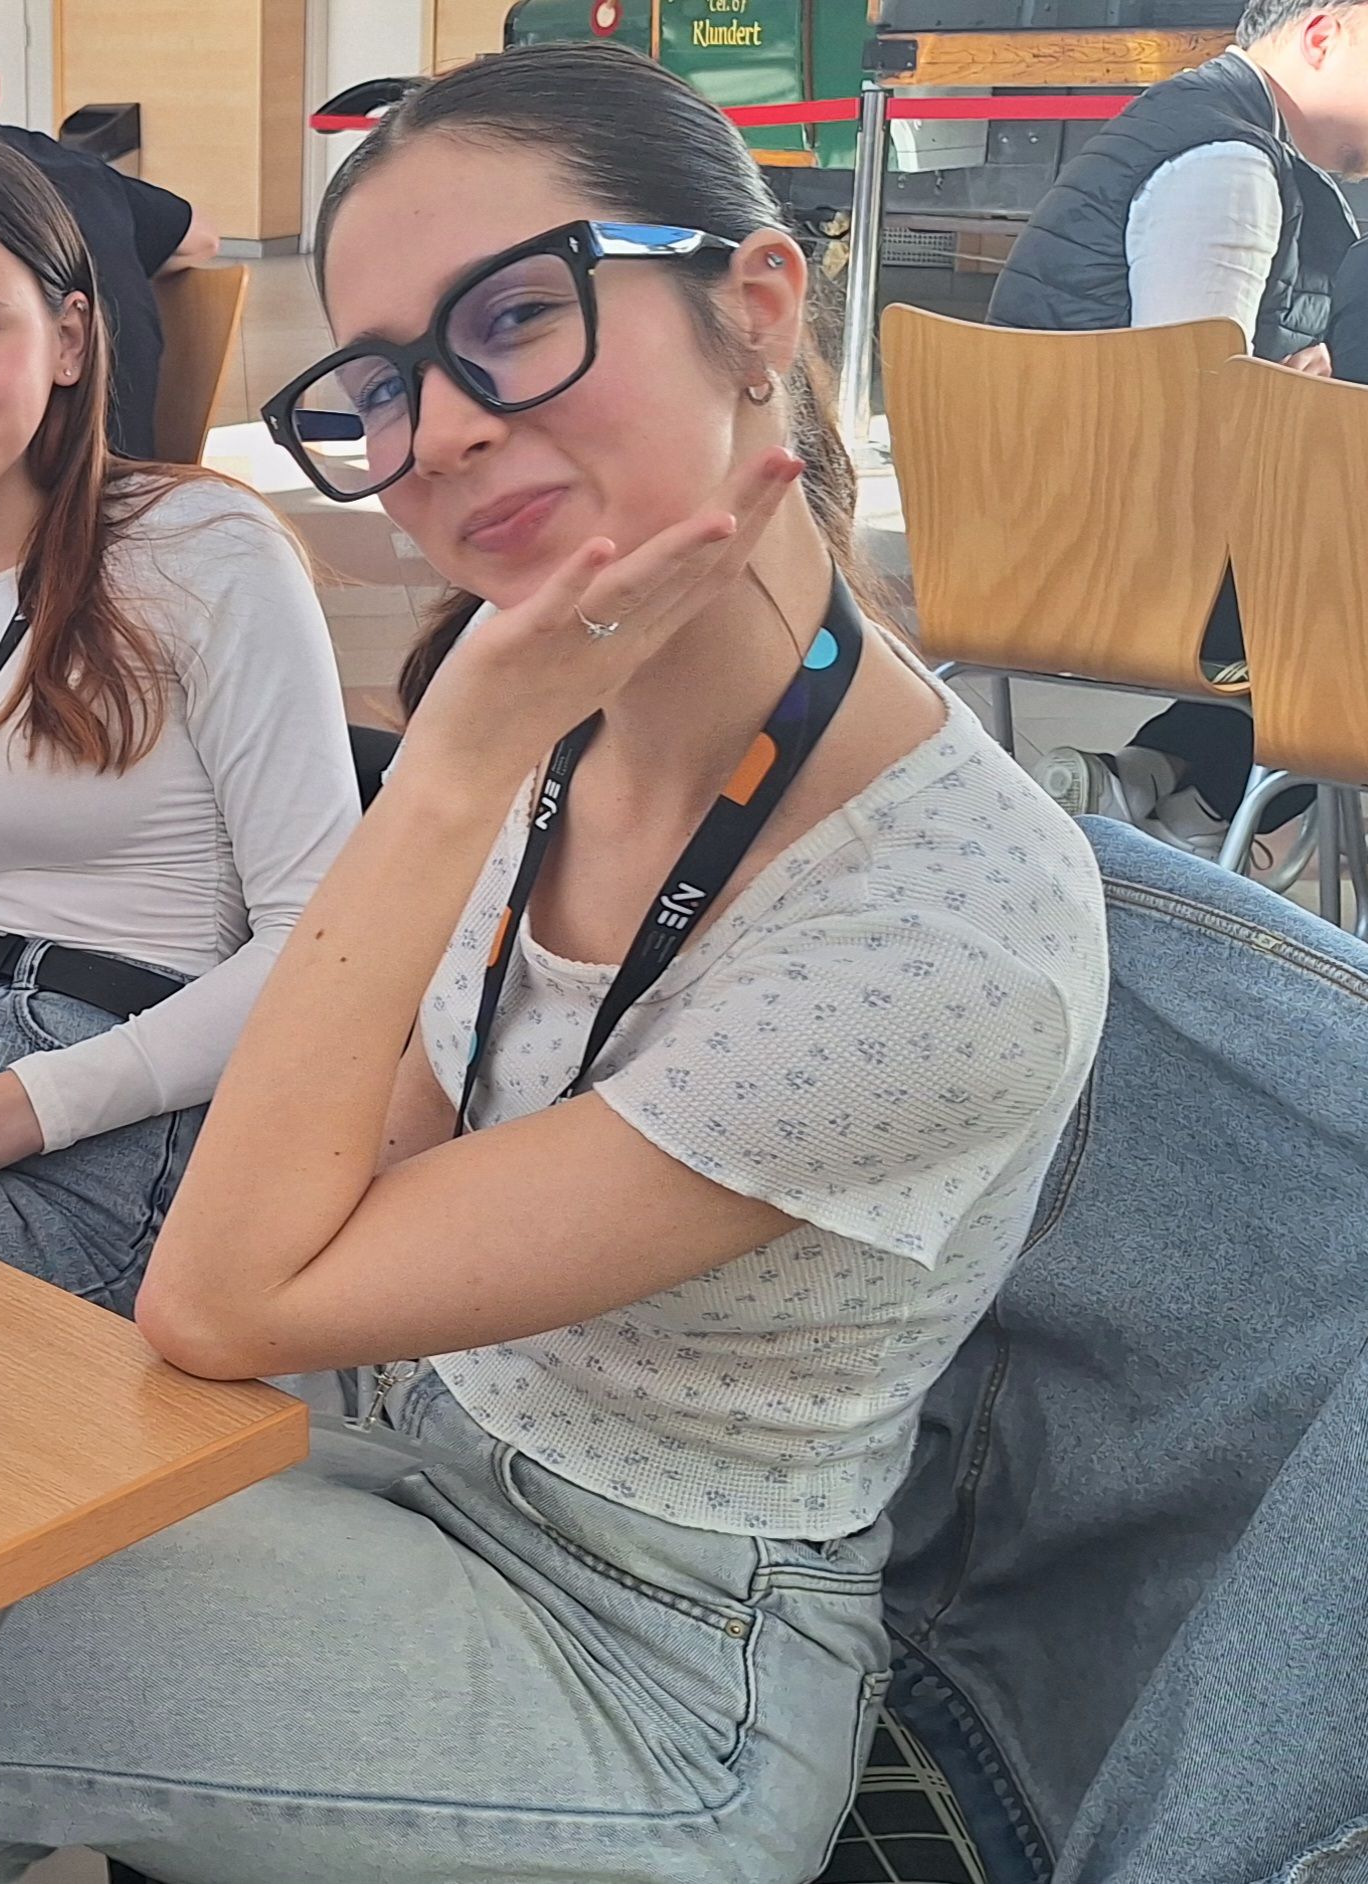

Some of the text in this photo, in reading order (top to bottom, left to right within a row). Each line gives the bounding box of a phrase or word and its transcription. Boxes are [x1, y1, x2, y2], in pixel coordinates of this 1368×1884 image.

[693, 18, 762, 47] Klundert
[534, 778, 562, 831] NJE
[656, 881, 707, 931] NJE
